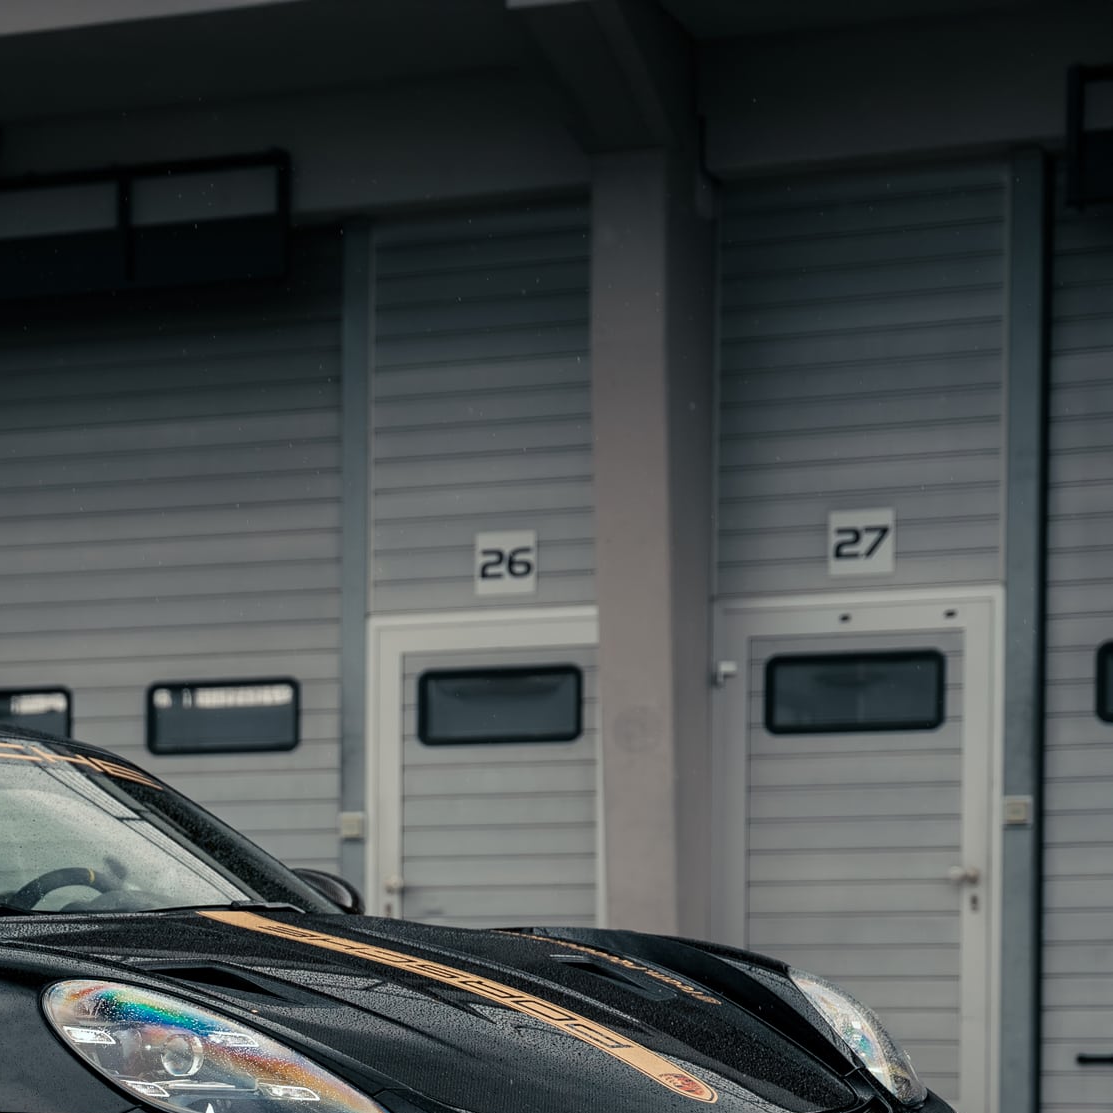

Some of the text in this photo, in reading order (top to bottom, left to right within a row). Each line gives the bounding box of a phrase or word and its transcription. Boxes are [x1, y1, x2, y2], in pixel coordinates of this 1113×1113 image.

[833, 525, 890, 560] 27
[479, 547, 535, 579] 26
[257, 923, 632, 1050] PORSCHE
